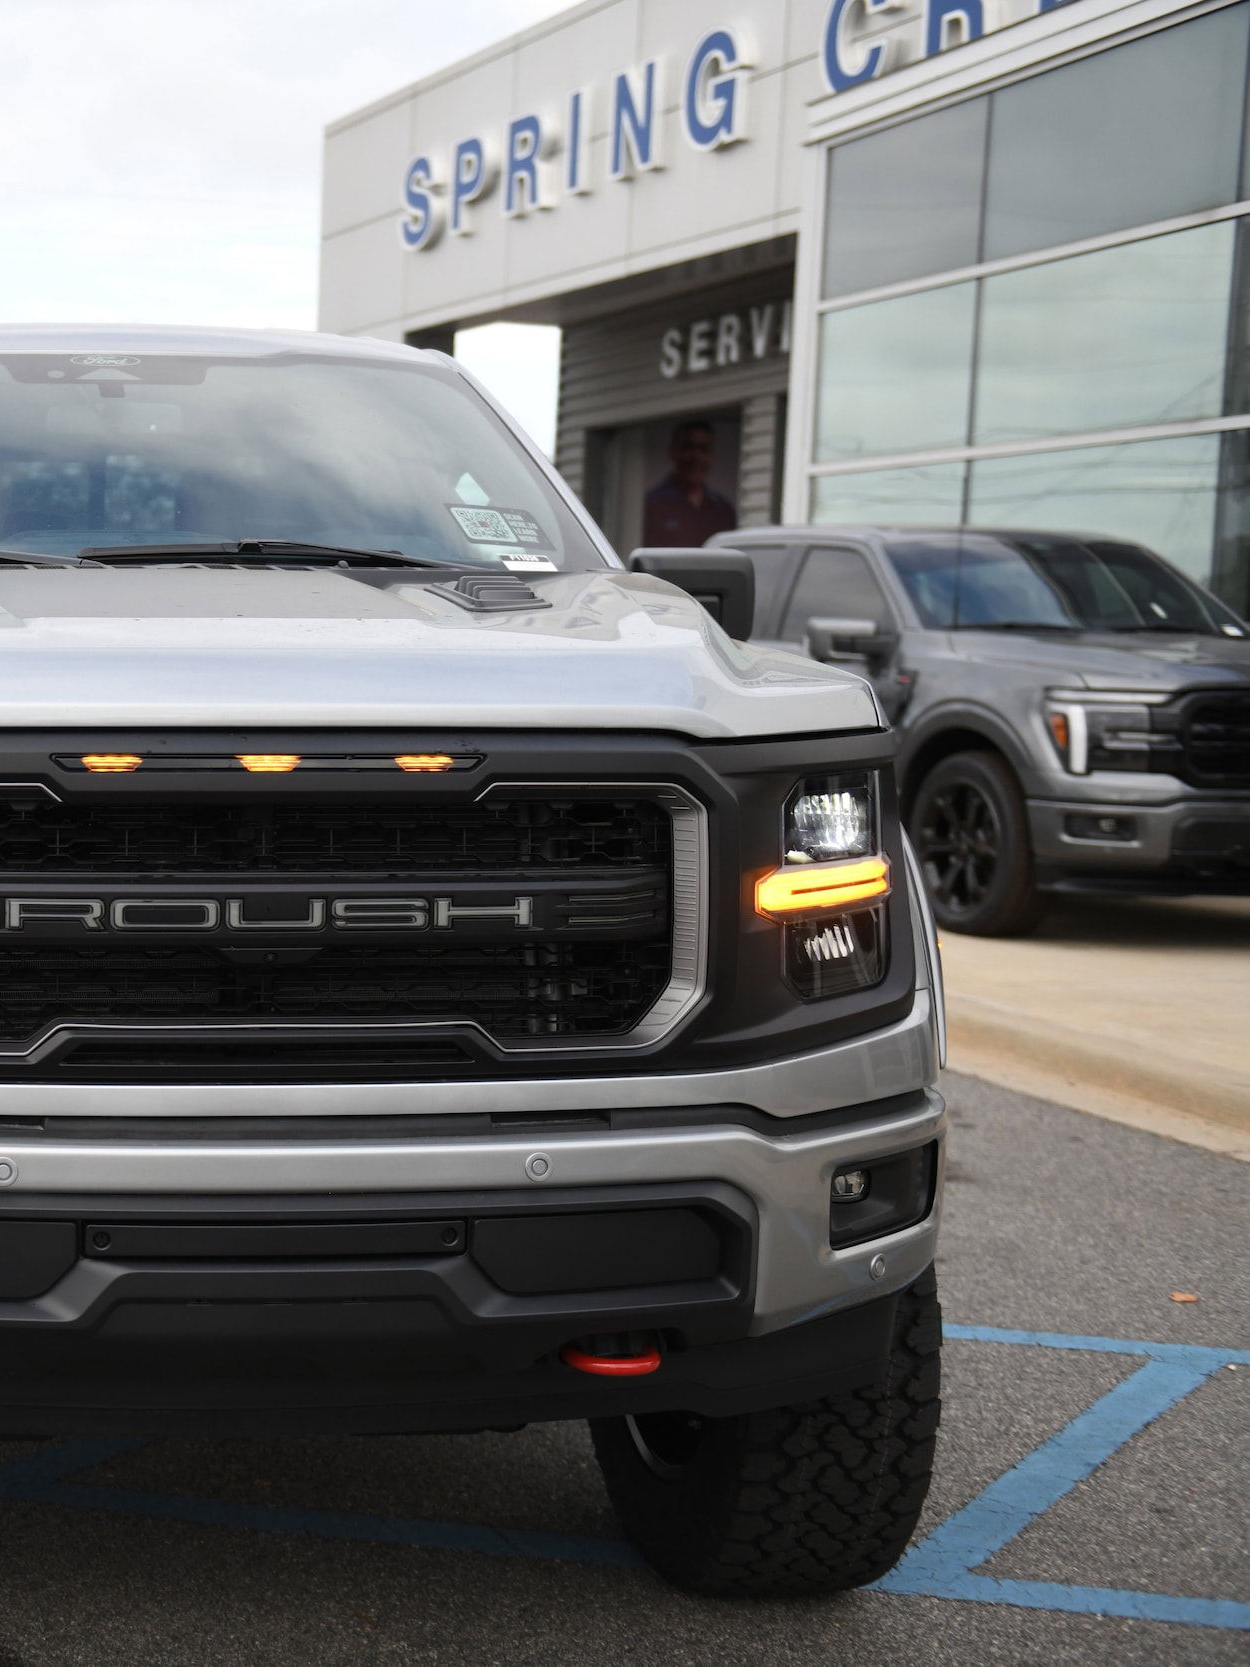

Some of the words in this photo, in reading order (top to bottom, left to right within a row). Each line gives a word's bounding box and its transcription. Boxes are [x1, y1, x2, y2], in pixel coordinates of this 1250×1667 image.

[401, 28, 742, 249] SPRING
[83, 355, 129, 365] Ford
[4, 897, 535, 930] ROUSH
